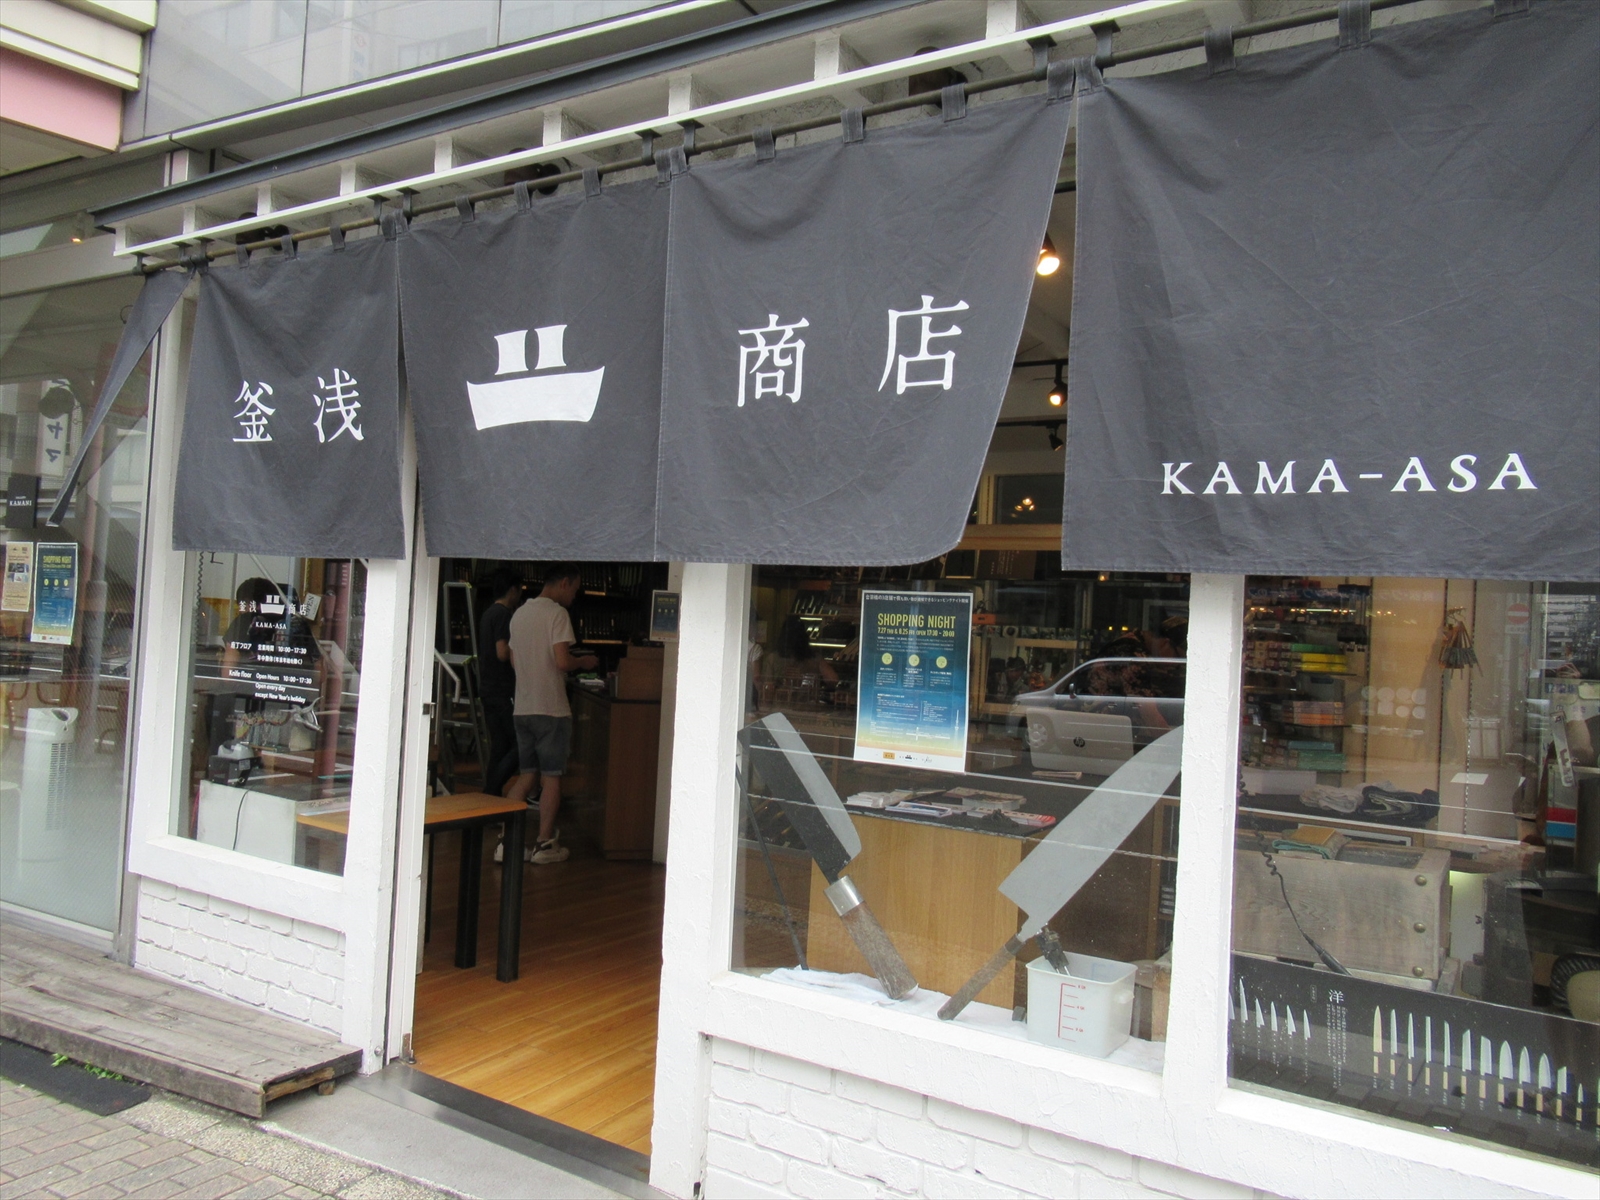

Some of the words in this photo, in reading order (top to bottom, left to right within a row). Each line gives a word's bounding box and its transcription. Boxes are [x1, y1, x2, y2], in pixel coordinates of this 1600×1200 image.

[232, 368, 365, 443] 釜浅
[737, 294, 970, 408] 商店
[1160, 453, 1538, 495] KAMA-ASA
[239, 600, 257, 613] 釜浅
[255, 621, 287, 630] KAMA-ASA
[877, 613, 925, 628] SHOPPING
[927, 615, 956, 629] NIGHT
[240, 670, 252, 678] floor
[255, 682, 267, 690] Open
[290, 695, 306, 704] holiday
[1328, 989, 1345, 1004] 洋
